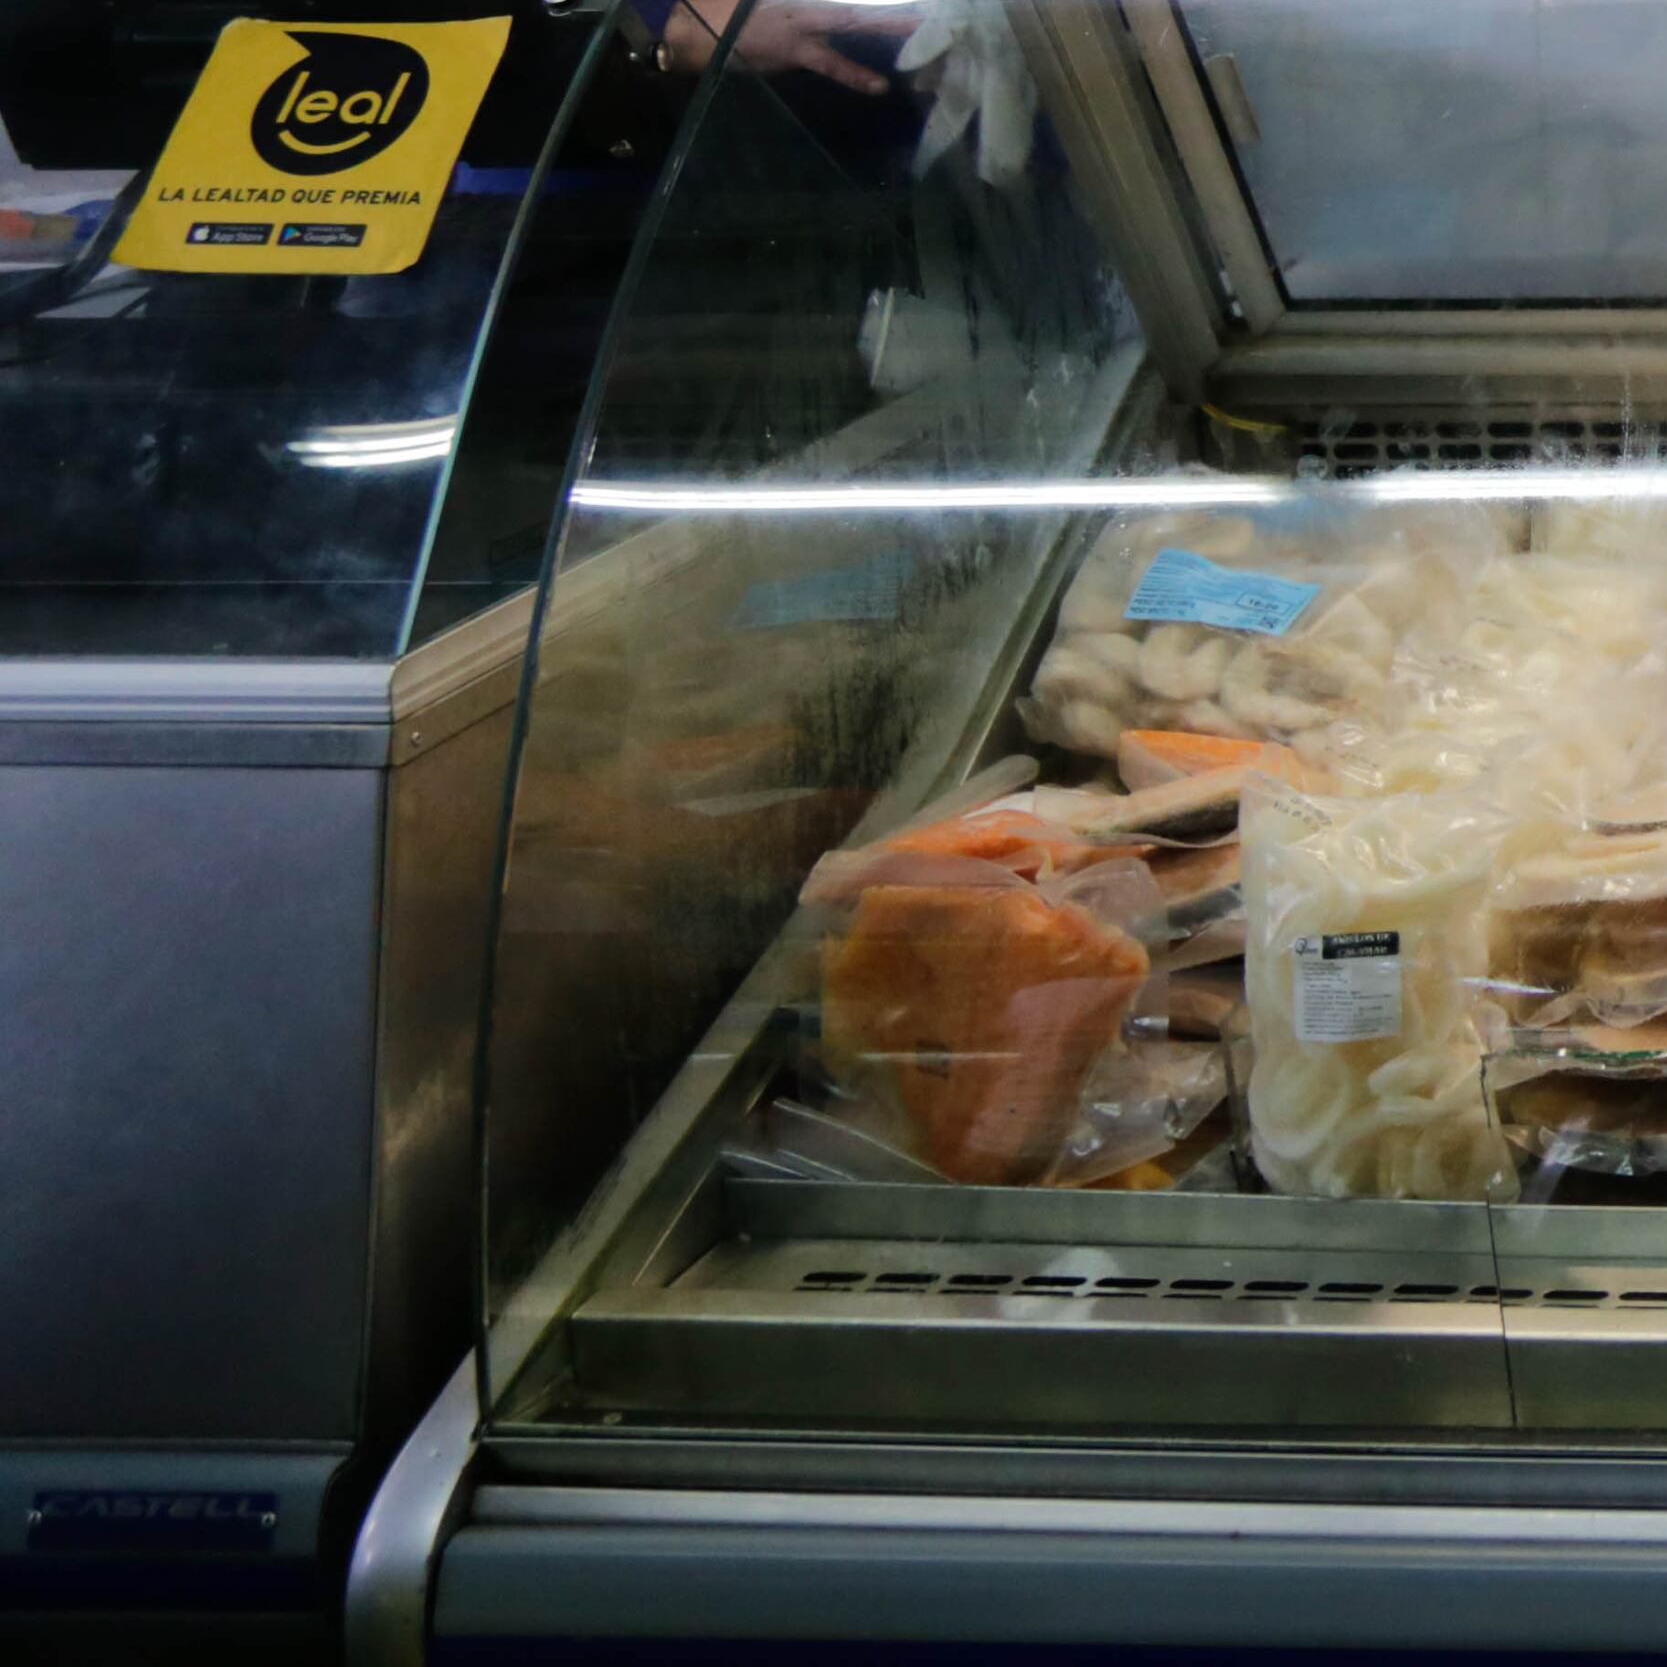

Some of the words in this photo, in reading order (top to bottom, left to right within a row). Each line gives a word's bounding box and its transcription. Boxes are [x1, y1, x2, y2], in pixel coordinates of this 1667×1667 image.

[276, 71, 412, 124] leal
[158, 188, 184, 202] LA
[192, 188, 286, 203] LEALTAD
[292, 190, 336, 204] QUE
[340, 191, 422, 205] PREMIA
[43, 1495, 264, 1518] CASTELL
